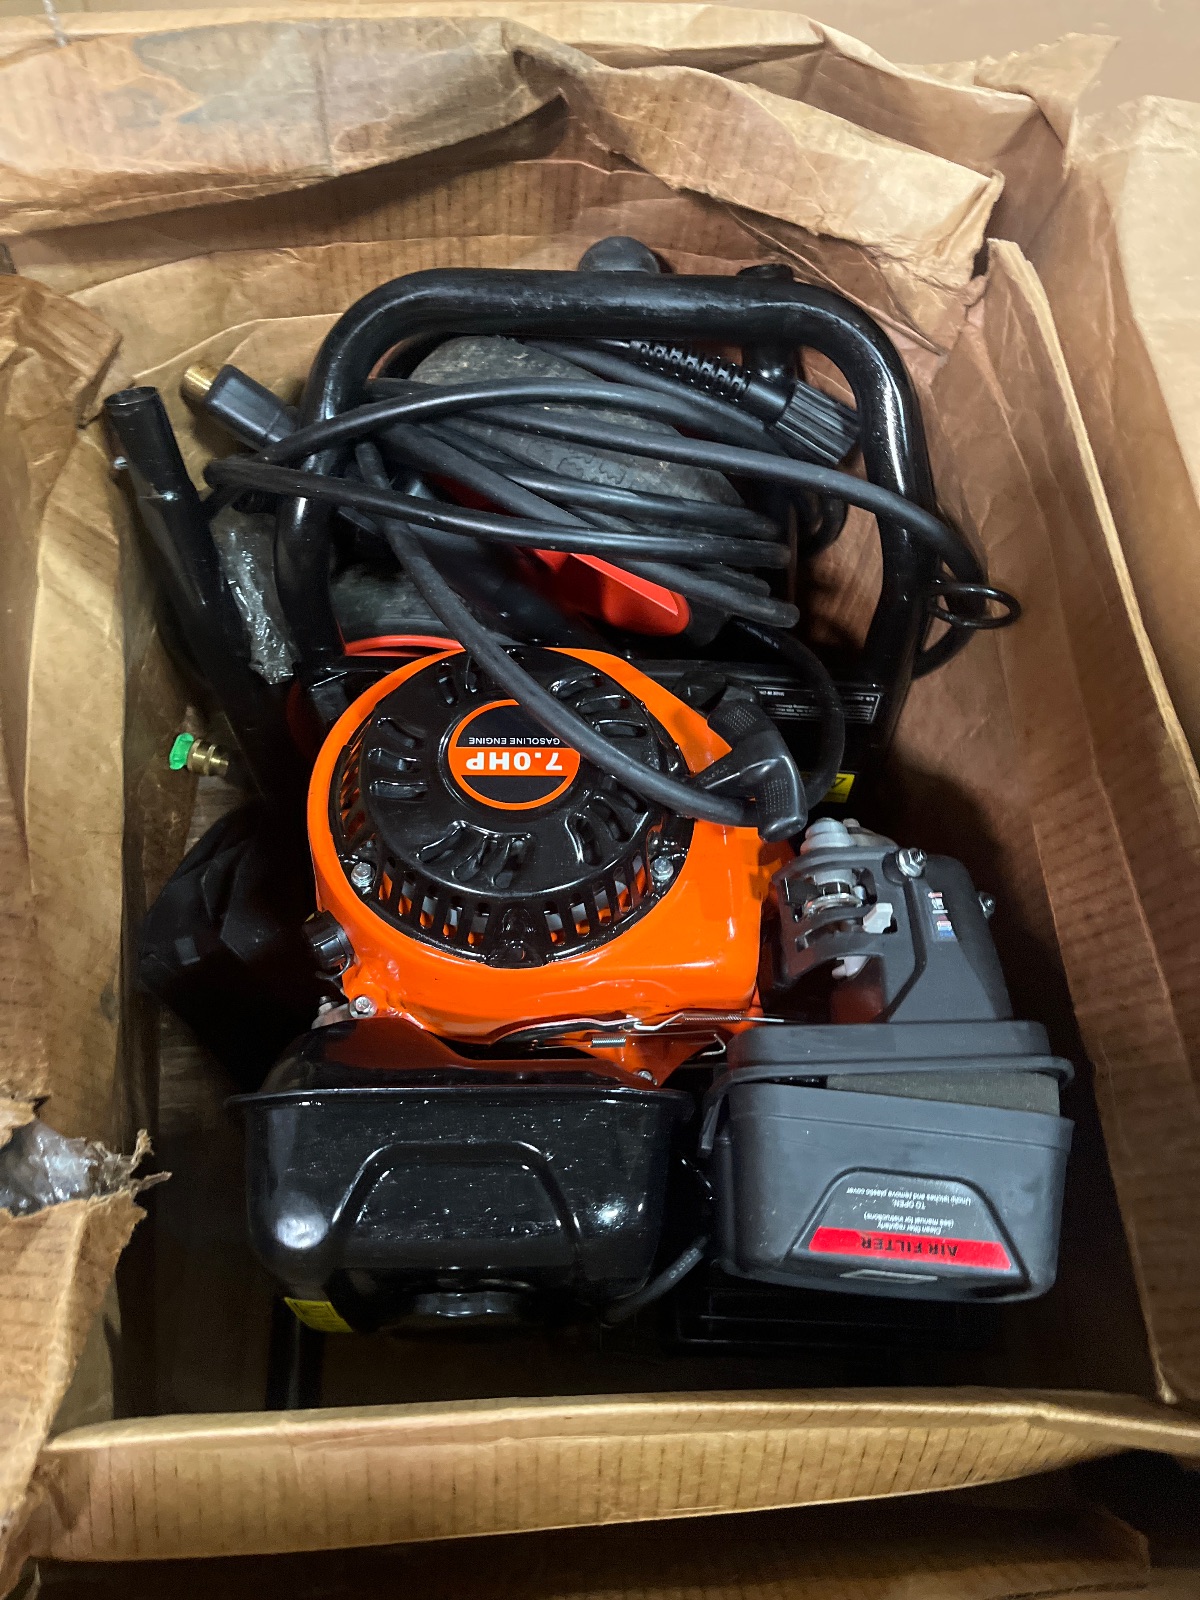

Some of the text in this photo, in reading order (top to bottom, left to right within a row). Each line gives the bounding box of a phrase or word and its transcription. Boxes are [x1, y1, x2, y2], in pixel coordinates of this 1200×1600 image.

[469, 737, 560, 745] GASOLINE ENGINE
[466, 752, 562, 771] 7.0HP
[846, 1186, 866, 1195] cover
[865, 1187, 889, 1198] plastic
[887, 1190, 913, 1200] remove
[912, 1192, 926, 1201] and
[926, 1193, 950, 1204] latches
[915, 1200, 926, 1210] TO
[863, 1211, 954, 1229] (see manual for instructions)
[877, 1220, 942, 1236] Clean filter regularly
[861, 1237, 957, 1256] AIR FILTER
